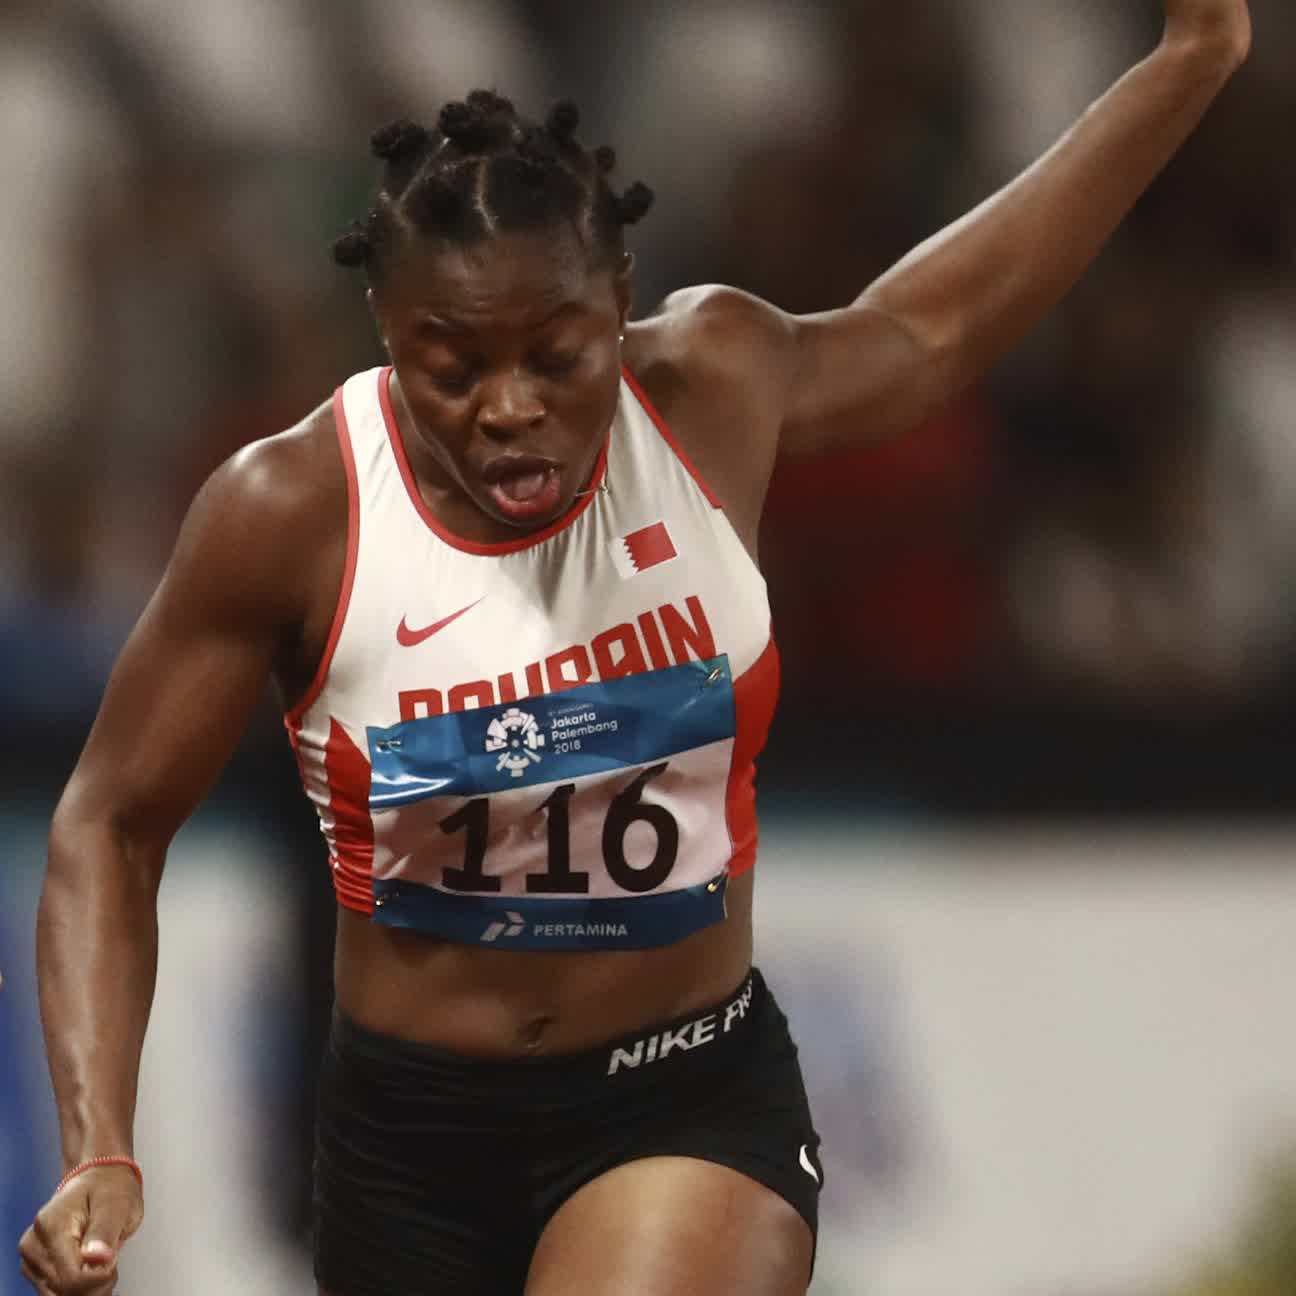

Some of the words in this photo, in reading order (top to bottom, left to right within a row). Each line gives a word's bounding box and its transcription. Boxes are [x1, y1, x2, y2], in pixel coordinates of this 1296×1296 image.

[551, 712, 597, 729] Jakarta
[552, 720, 618, 741] Palembang
[439, 761, 679, 893] 116
[533, 924, 628, 937] PERTAMINA
[608, 1014, 717, 1076] NIKE
[723, 979, 753, 1033] PR
